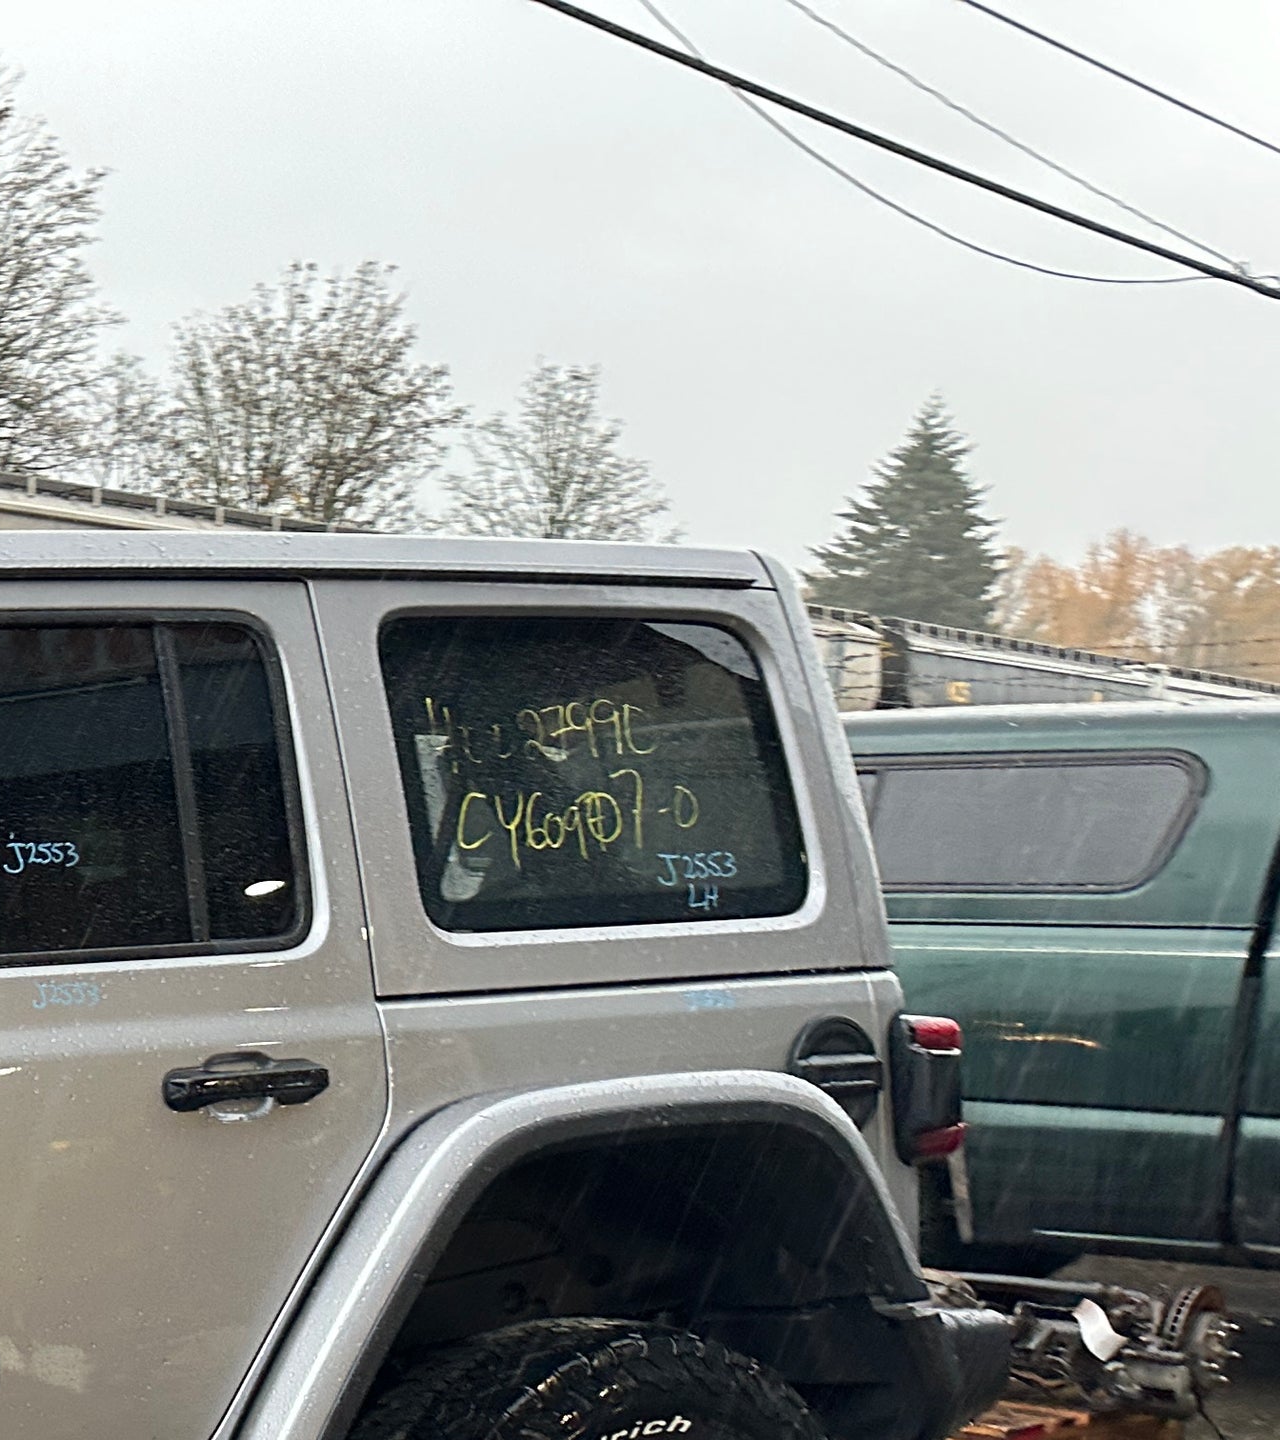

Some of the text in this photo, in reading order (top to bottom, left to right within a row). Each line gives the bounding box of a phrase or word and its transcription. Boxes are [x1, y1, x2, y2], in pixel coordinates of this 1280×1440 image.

[3, 838, 80, 874] J2553
[657, 852, 737, 886] J2553
[688, 883, 719, 908] LH
